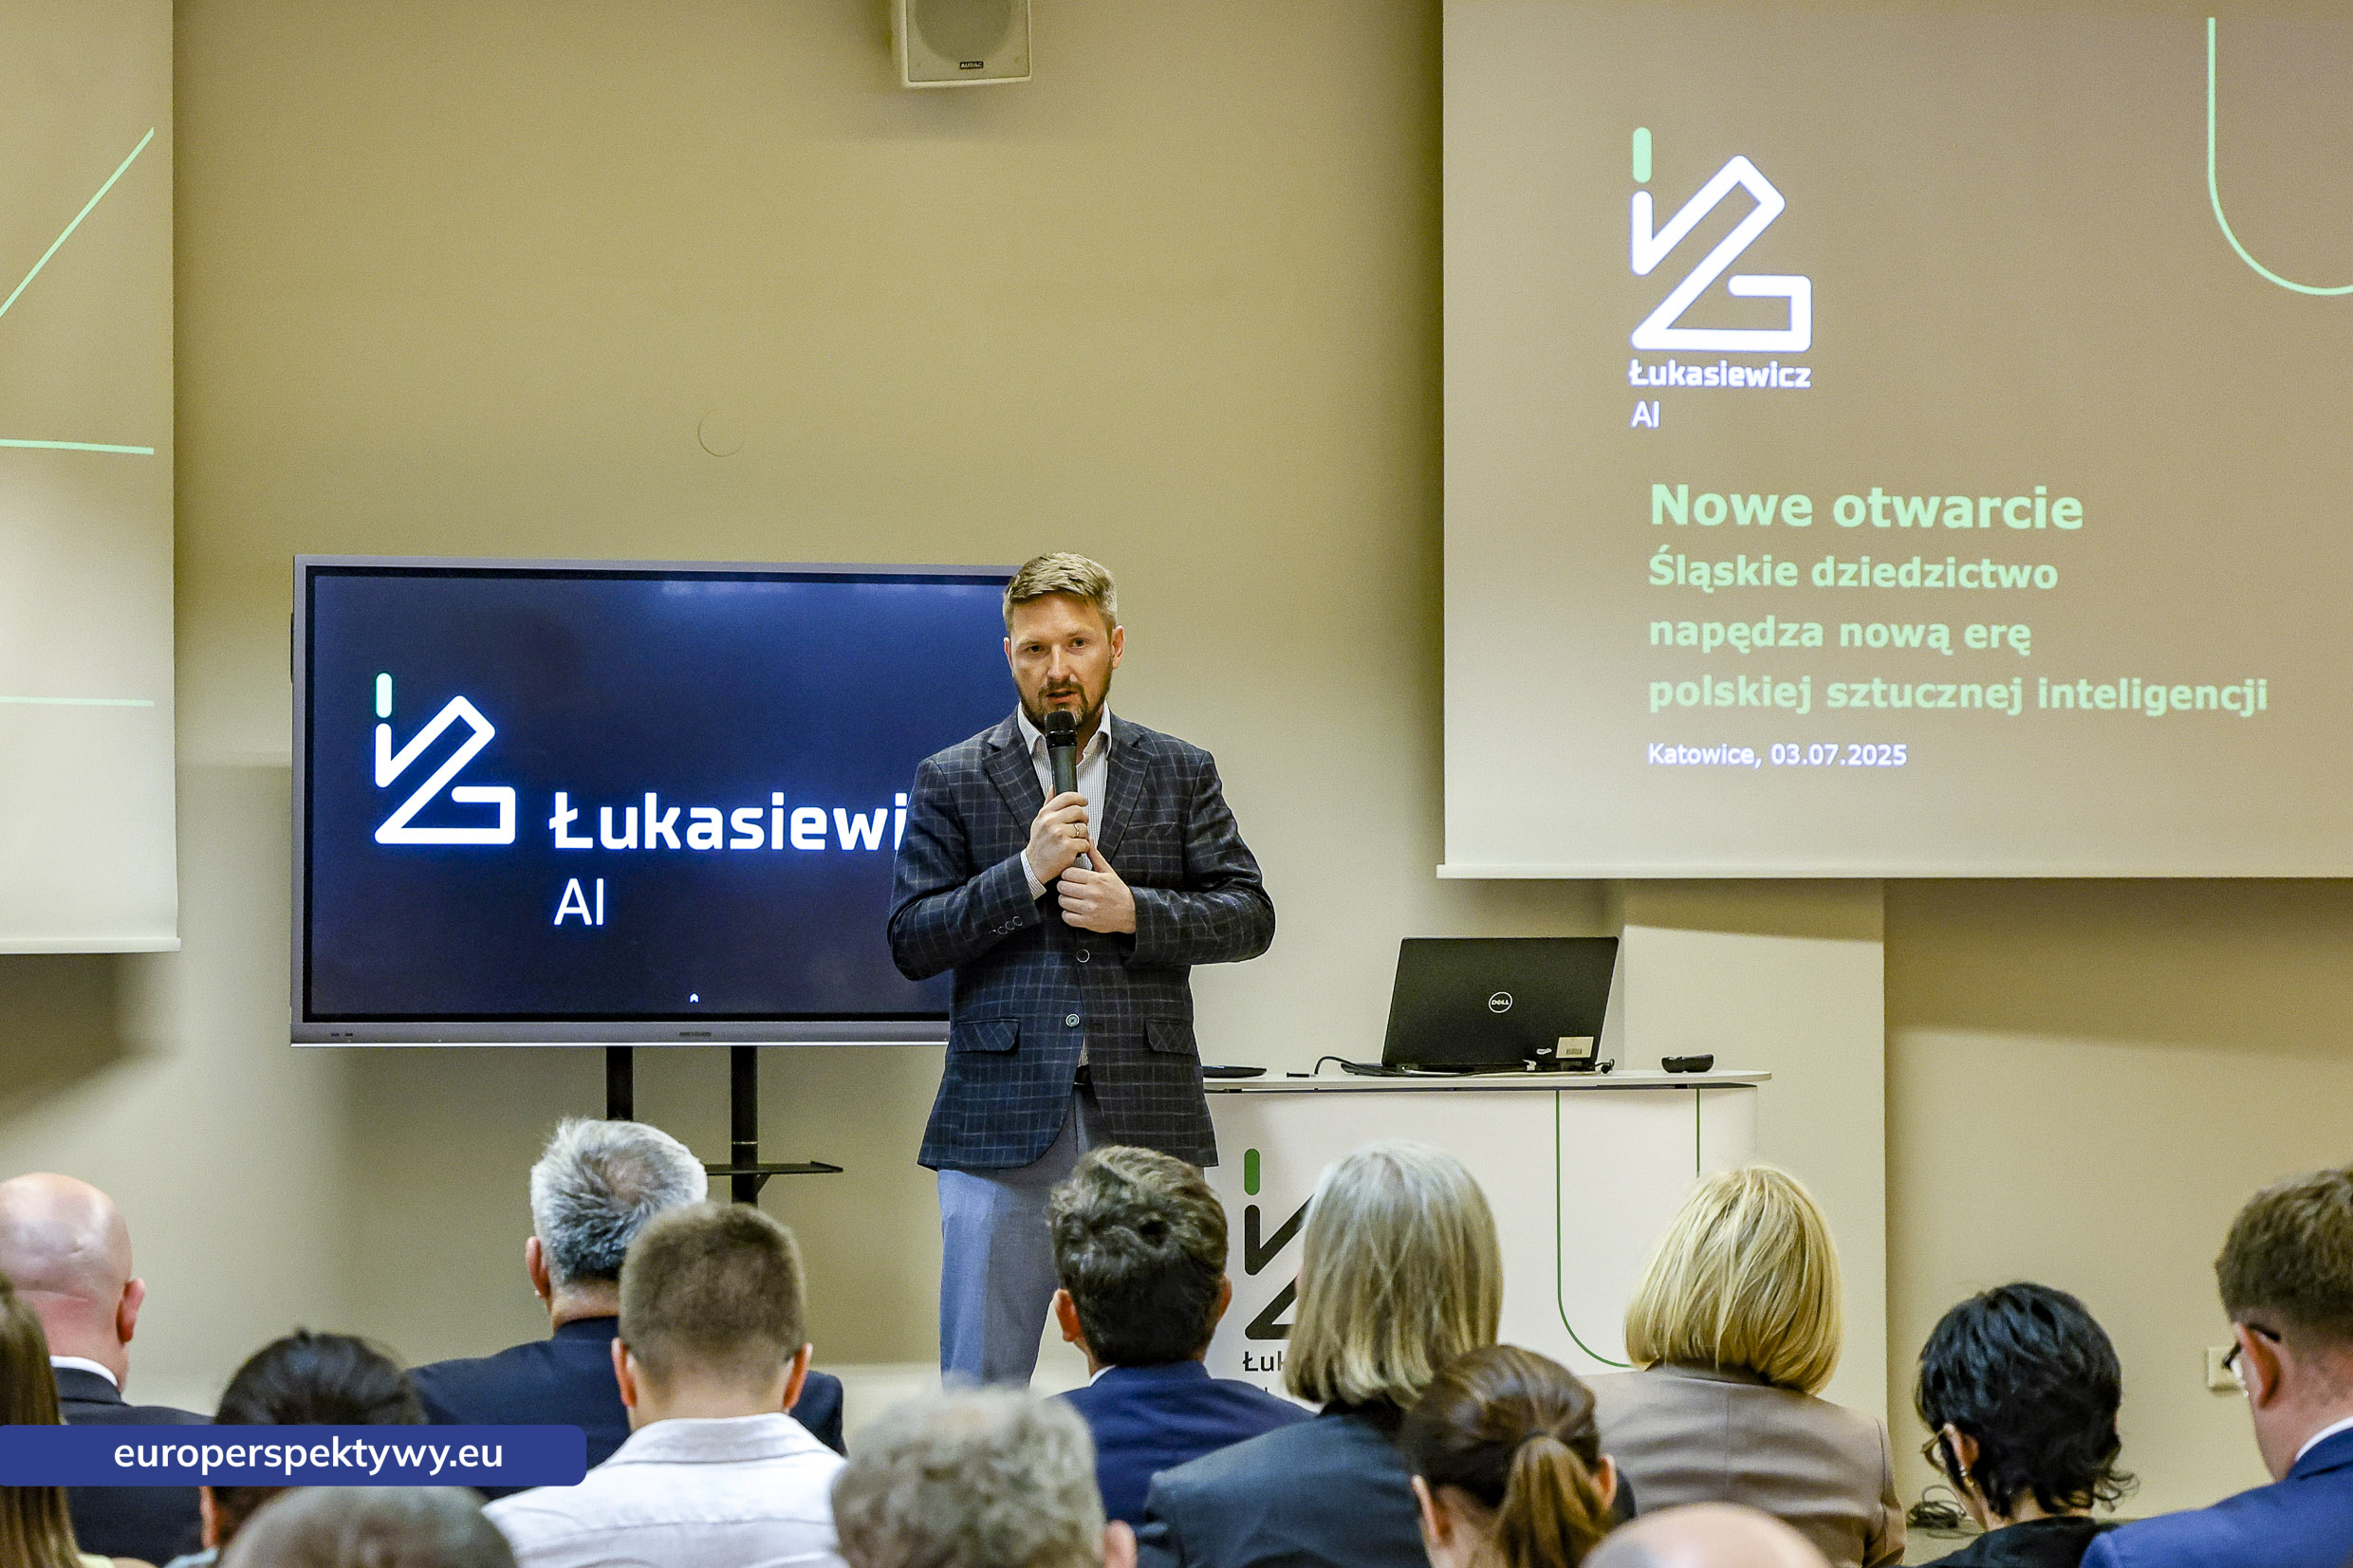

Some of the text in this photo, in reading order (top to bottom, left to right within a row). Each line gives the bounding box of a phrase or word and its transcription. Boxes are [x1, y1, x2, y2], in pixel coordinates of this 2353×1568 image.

[1628, 359, 1812, 389] Łukasiewicz
[1631, 400, 1660, 429] AI
[1651, 484, 2084, 530] Nowe otwarcie
[1649, 544, 2059, 594] Śląskie dziedzictwo
[1650, 615, 2032, 656] napędza nową erę
[1649, 674, 2269, 718] polskiej sztucznej inteligencji
[1648, 744, 1908, 769] Katowice, 03.07.2025
[553, 877, 604, 926] AI
